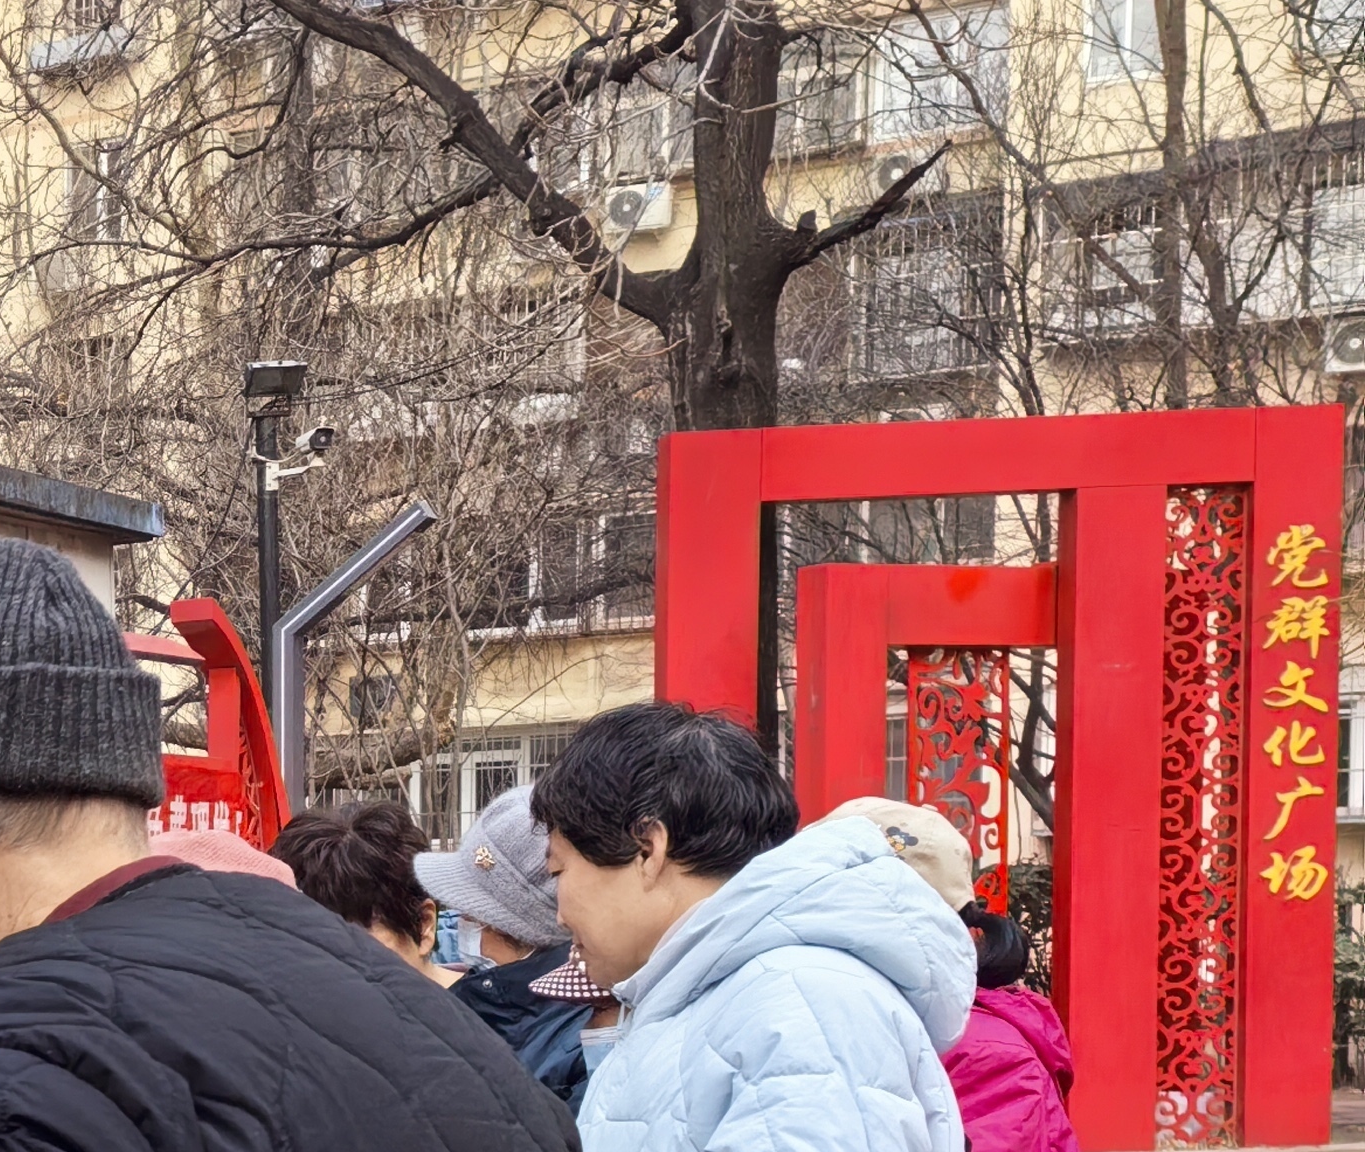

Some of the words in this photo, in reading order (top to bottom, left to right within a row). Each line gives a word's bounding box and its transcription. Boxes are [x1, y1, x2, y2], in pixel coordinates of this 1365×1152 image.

[1260, 523, 1332, 901] 党群文化广场
